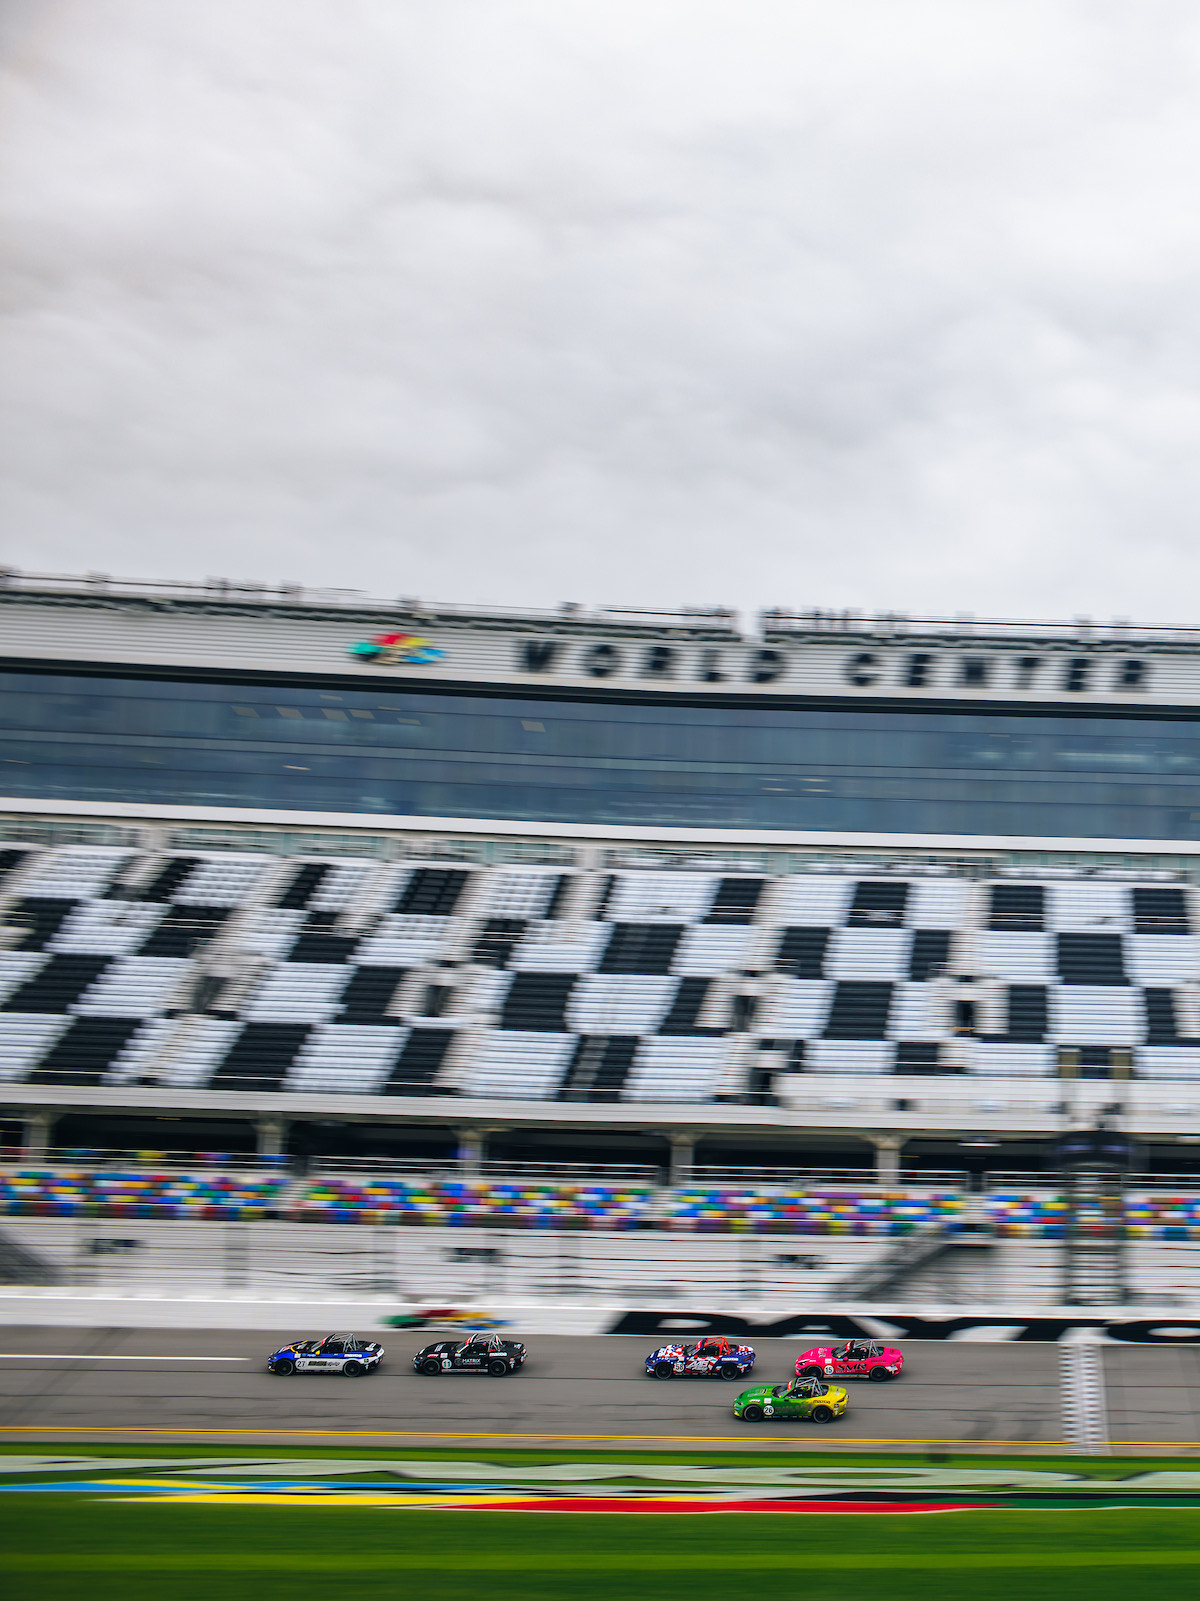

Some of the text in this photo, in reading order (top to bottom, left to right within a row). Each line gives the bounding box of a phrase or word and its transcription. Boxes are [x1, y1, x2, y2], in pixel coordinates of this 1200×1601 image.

[517, 640, 784, 682] WORLD
[845, 653, 1148, 692] CENTER
[837, 1363, 867, 1371] SMR
